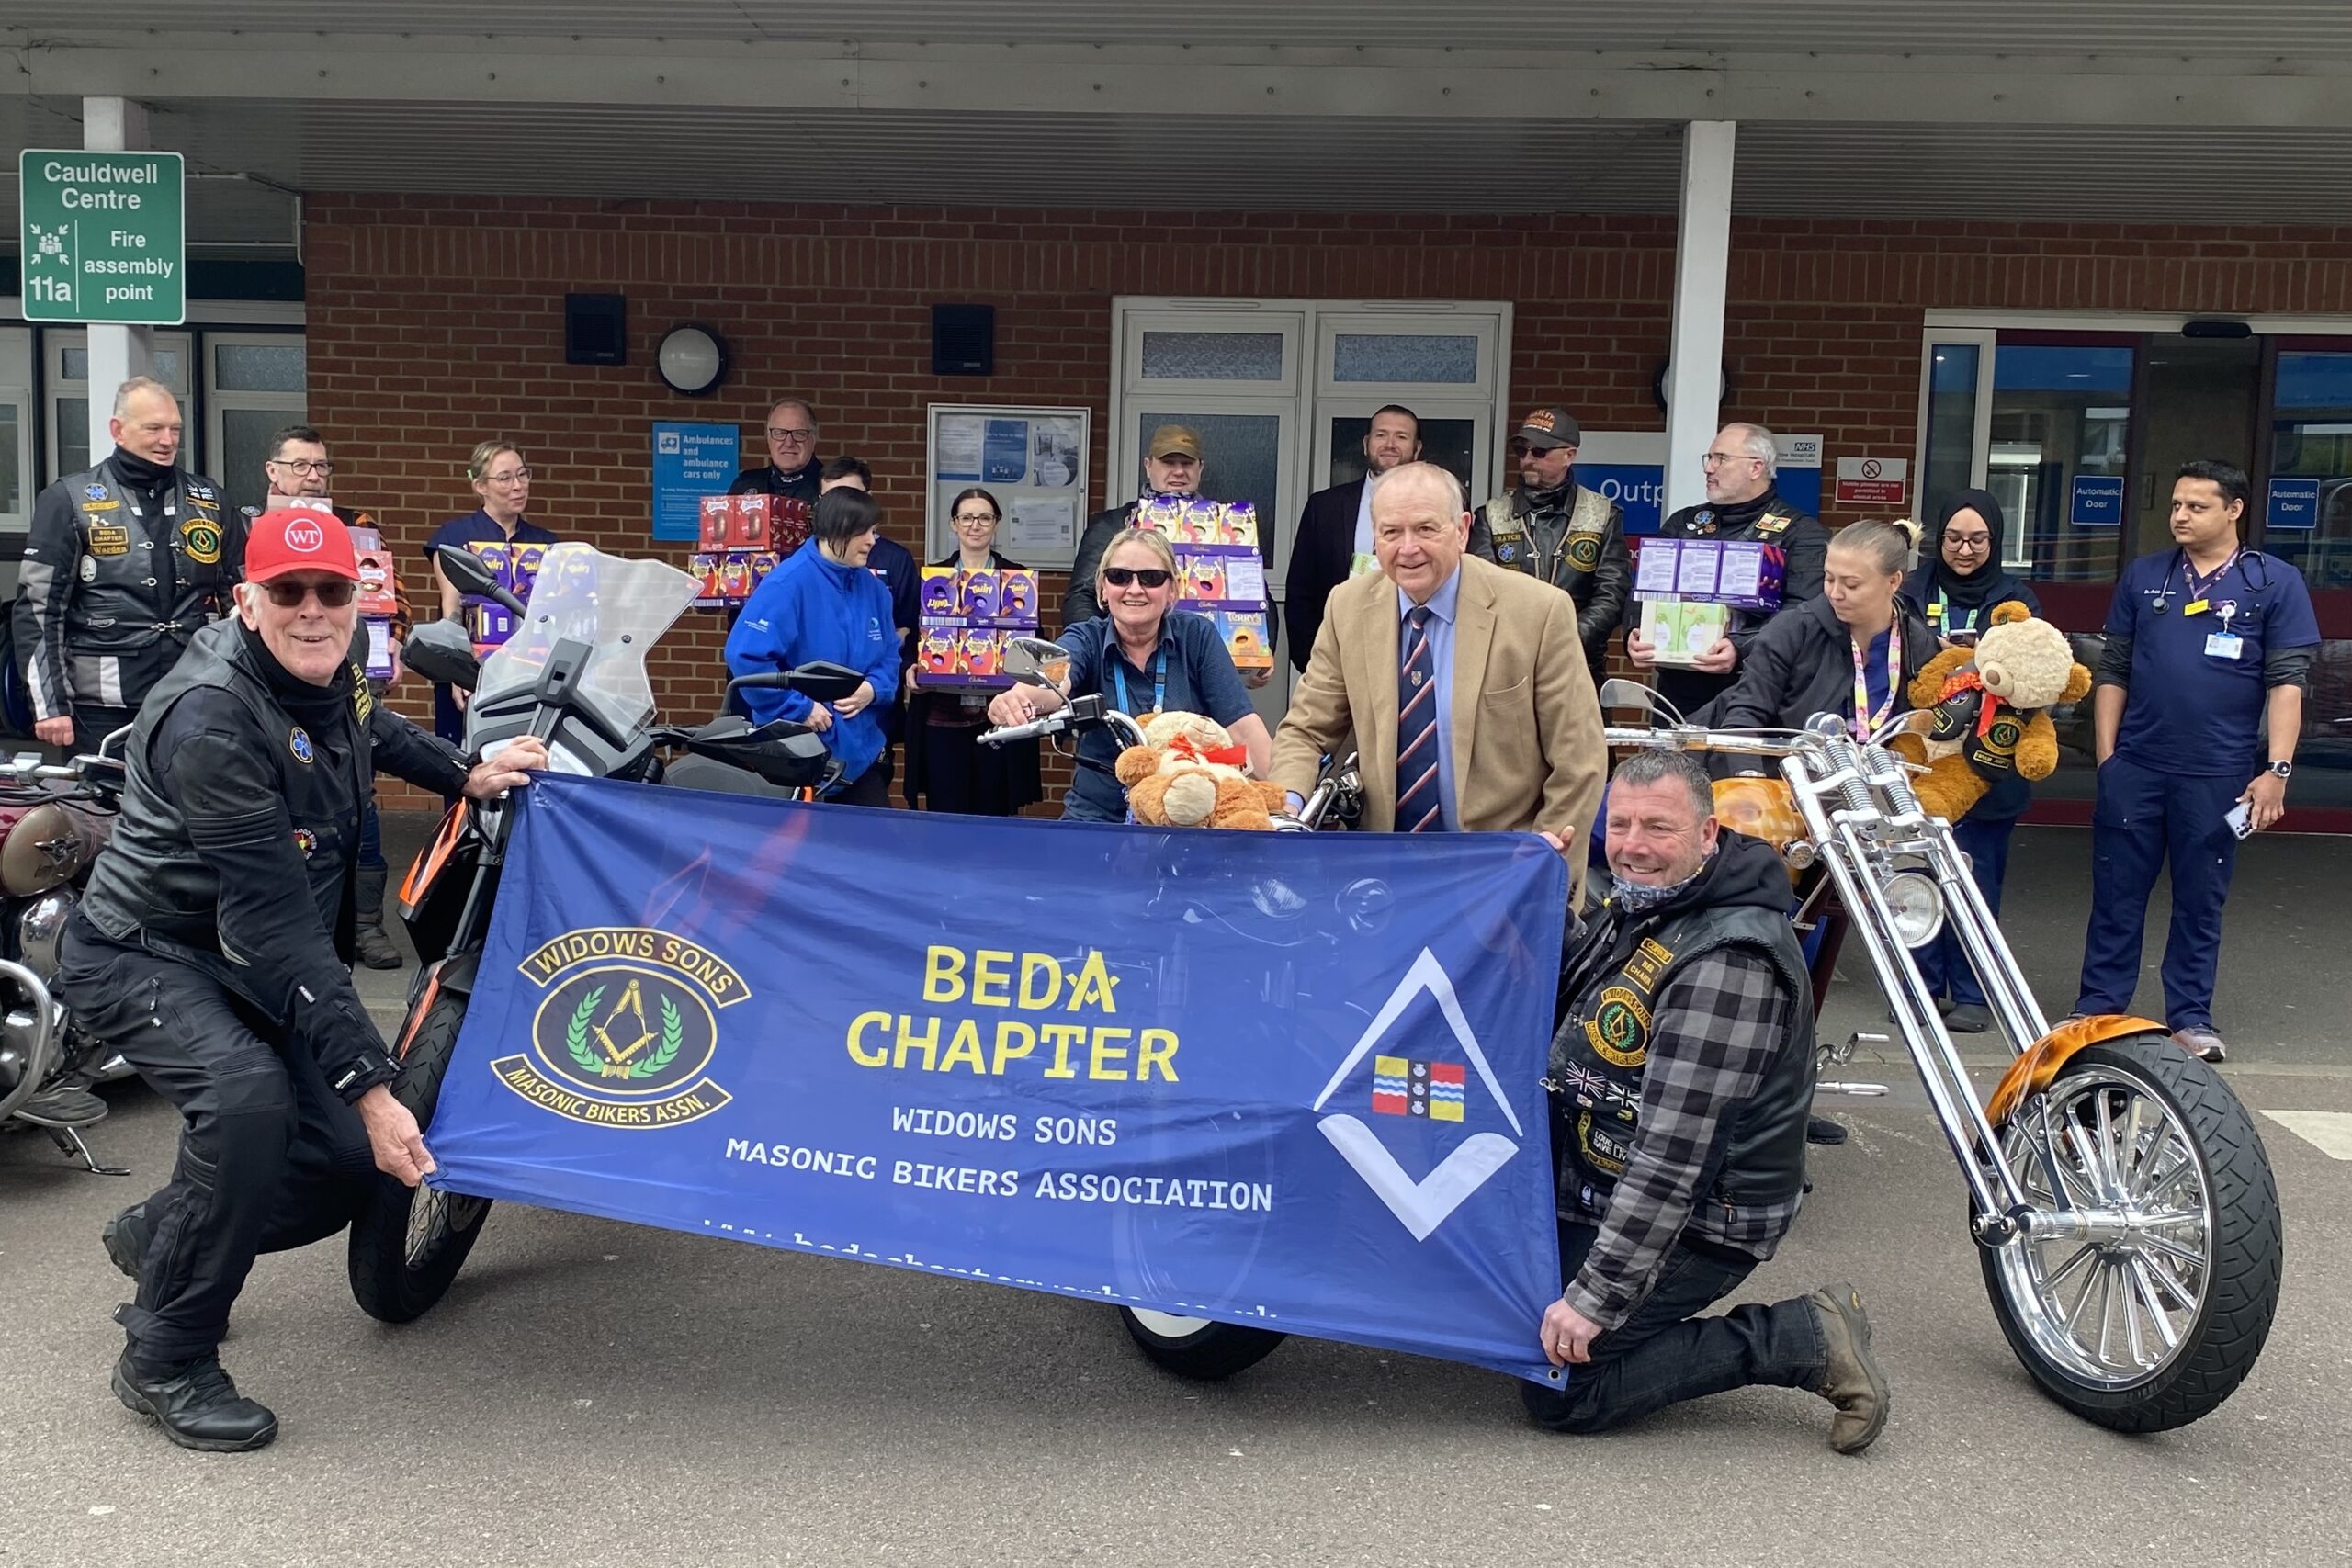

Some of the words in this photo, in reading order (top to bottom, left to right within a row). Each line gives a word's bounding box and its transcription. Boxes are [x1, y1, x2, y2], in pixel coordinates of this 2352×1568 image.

[44, 161, 158, 184] Cauldwell
[61, 187, 141, 210] Centre
[110, 230, 146, 248] Fire
[84, 256, 174, 279] assembly
[29, 276, 72, 302] 11a
[105, 284, 153, 303] point
[683, 435, 734, 446] Ambulances
[1795, 442, 1816, 452] NHS
[683, 447, 699, 456] and
[683, 458, 729, 468] ambulance
[683, 470, 701, 479] cars
[702, 470, 721, 480] only
[2076, 488, 2120, 496] Automatic
[2272, 491, 2316, 499] Automatic
[2086, 500, 2109, 508] Door
[2281, 502, 2304, 511] Door
[289, 529, 318, 545] WT
[93, 545, 128, 554] Warden
[967, 584, 993, 594] Twirl
[1008, 583, 1030, 593] Twirl
[534, 932, 655, 974] WIDOWS
[662, 939, 733, 995] SONS
[922, 945, 1120, 1013] BEDA
[846, 1011, 1180, 1082] CHAPTER
[505, 1066, 581, 1115] MASONIC
[585, 1106, 651, 1123] BIKERS
[655, 1095, 710, 1122] ASSN.
[892, 1106, 1017, 1141] WIDOWS
[1035, 1116, 1117, 1146] SONS
[1594, 1130, 1613, 1147] LOUD
[1592, 1139, 1612, 1155] SAVE
[725, 1138, 876, 1179] MASONIC
[892, 1162, 1020, 1196] BIKERS
[1035, 1170, 1273, 1212] ASSOCIATION
